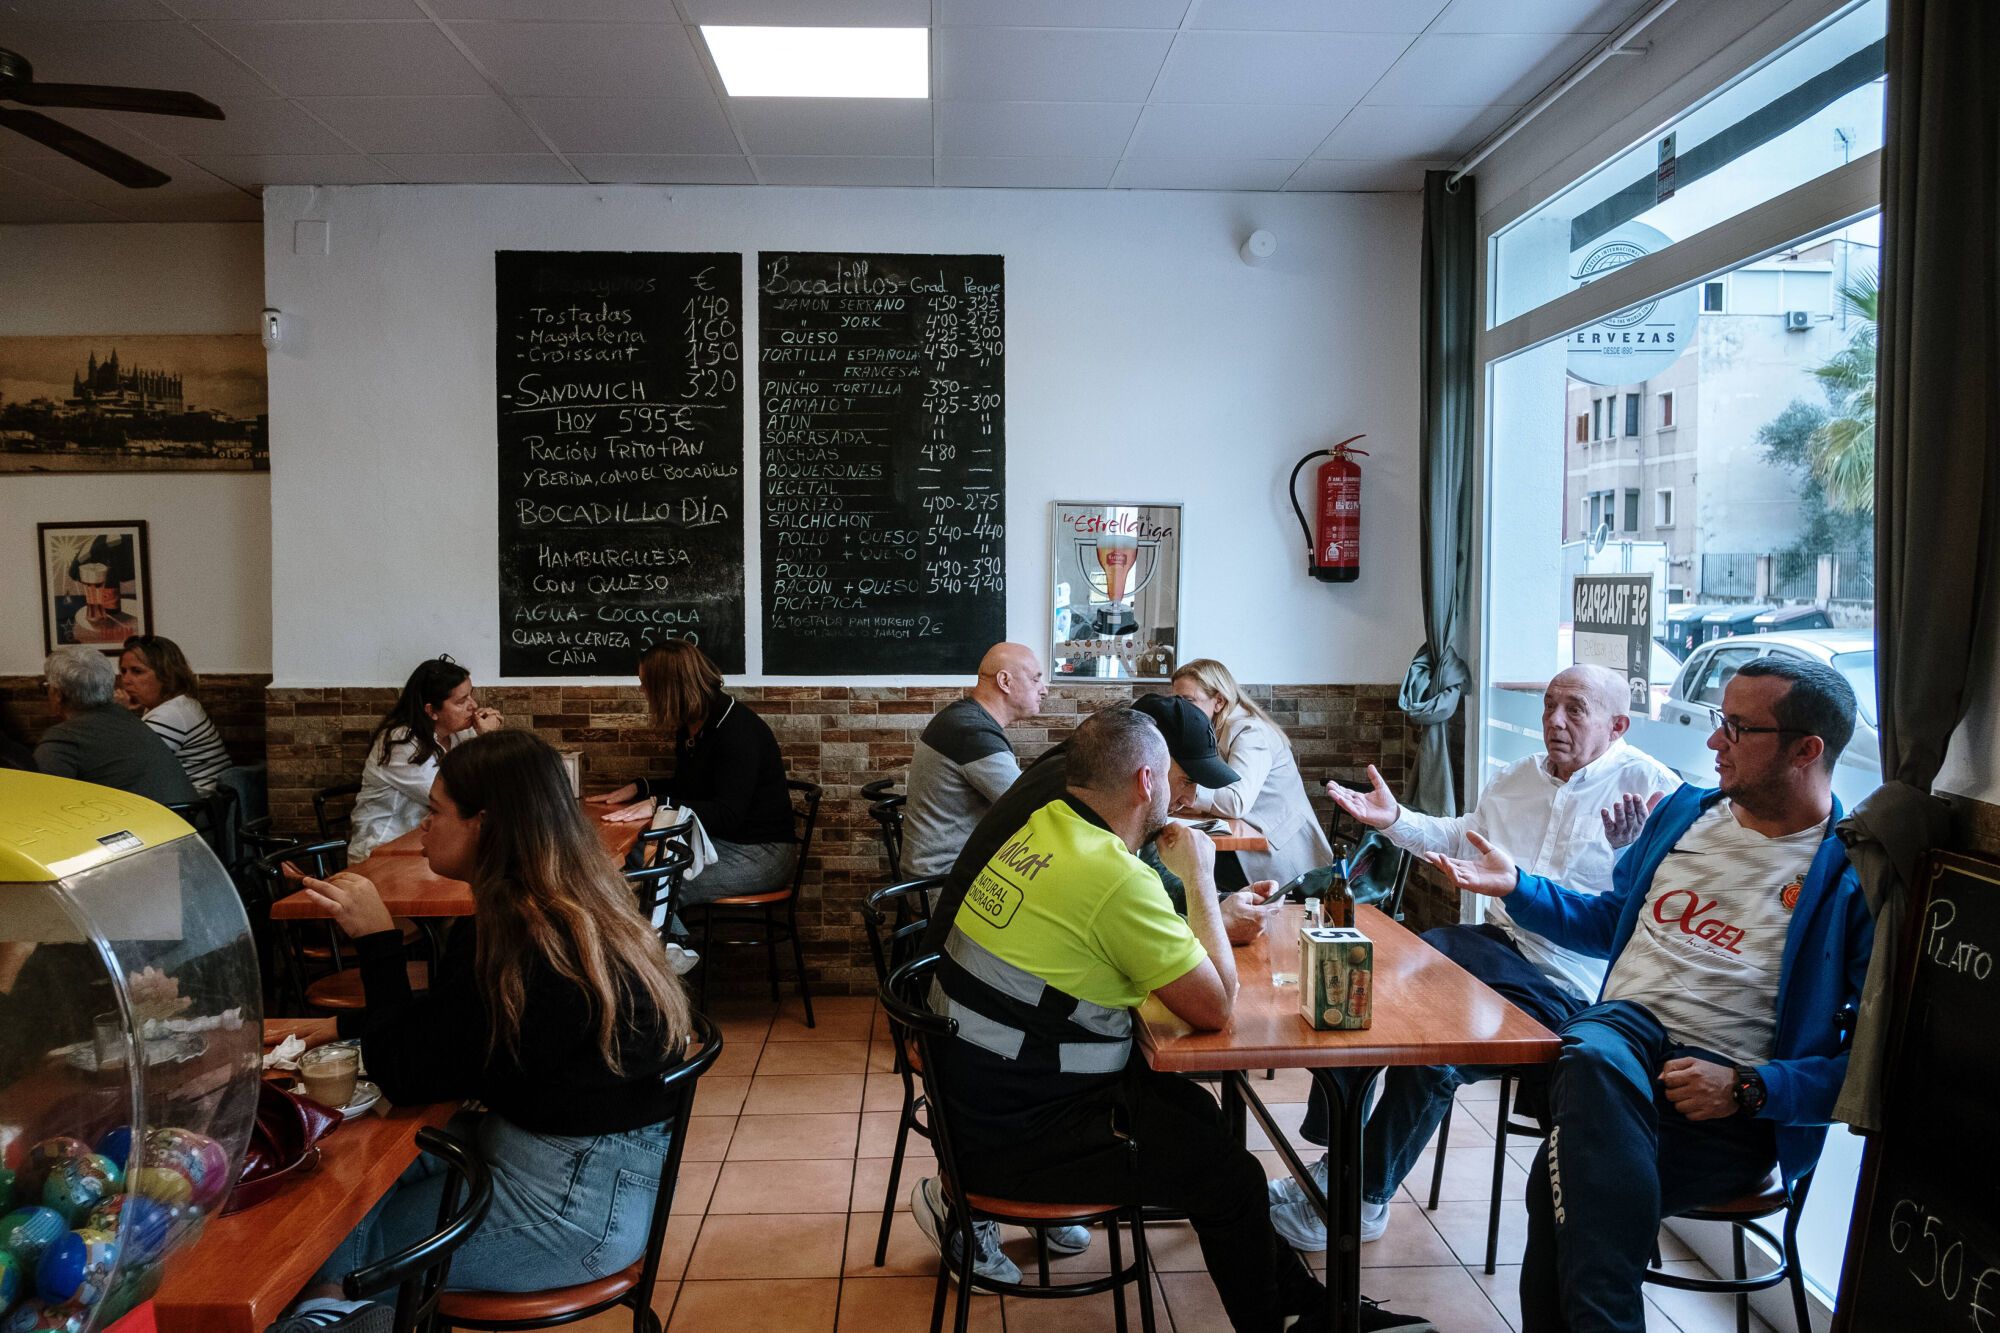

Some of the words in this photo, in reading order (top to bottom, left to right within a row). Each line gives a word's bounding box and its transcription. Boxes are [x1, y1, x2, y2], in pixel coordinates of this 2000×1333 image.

[689, 267, 716, 291] €
[839, 298, 905, 311] SERRANO
[529, 302, 633, 324] Tostadas
[840, 316, 883, 328] YORK
[780, 331, 838, 344] QUESO
[761, 348, 837, 362] TORTILLA
[515, 374, 646, 407] SANDWICH
[764, 381, 819, 396] PINCHO
[832, 383, 902, 395] TORTILLA
[556, 410, 597, 432] HOY
[766, 414, 811, 430] ATUN
[766, 448, 840, 462] ANCHOAS
[599, 470, 639, 484] COMO
[642, 467, 660, 481] EL
[766, 463, 883, 478] BOQUERONES
[768, 480, 839, 495] VEGETAL
[516, 498, 670, 524] BOCADILLO
[766, 497, 843, 512] CHORIZO
[767, 513, 874, 529] SALCHICHON
[1074, 513, 1138, 533] Estrella
[1140, 522, 1172, 543] Liga
[777, 531, 830, 546] POLLO
[858, 530, 919, 545] QUESO
[539, 544, 691, 568] HAMBURGUESA
[775, 563, 828, 578] POLLO
[533, 574, 575, 593] CON
[588, 574, 669, 594] QUESO
[773, 579, 832, 595] BACON
[858, 578, 919, 595] QUESO
[574, 631, 632, 648] CERVEZA
[548, 647, 597, 665] CAÑA
[1926, 899, 1992, 980] PLATO
